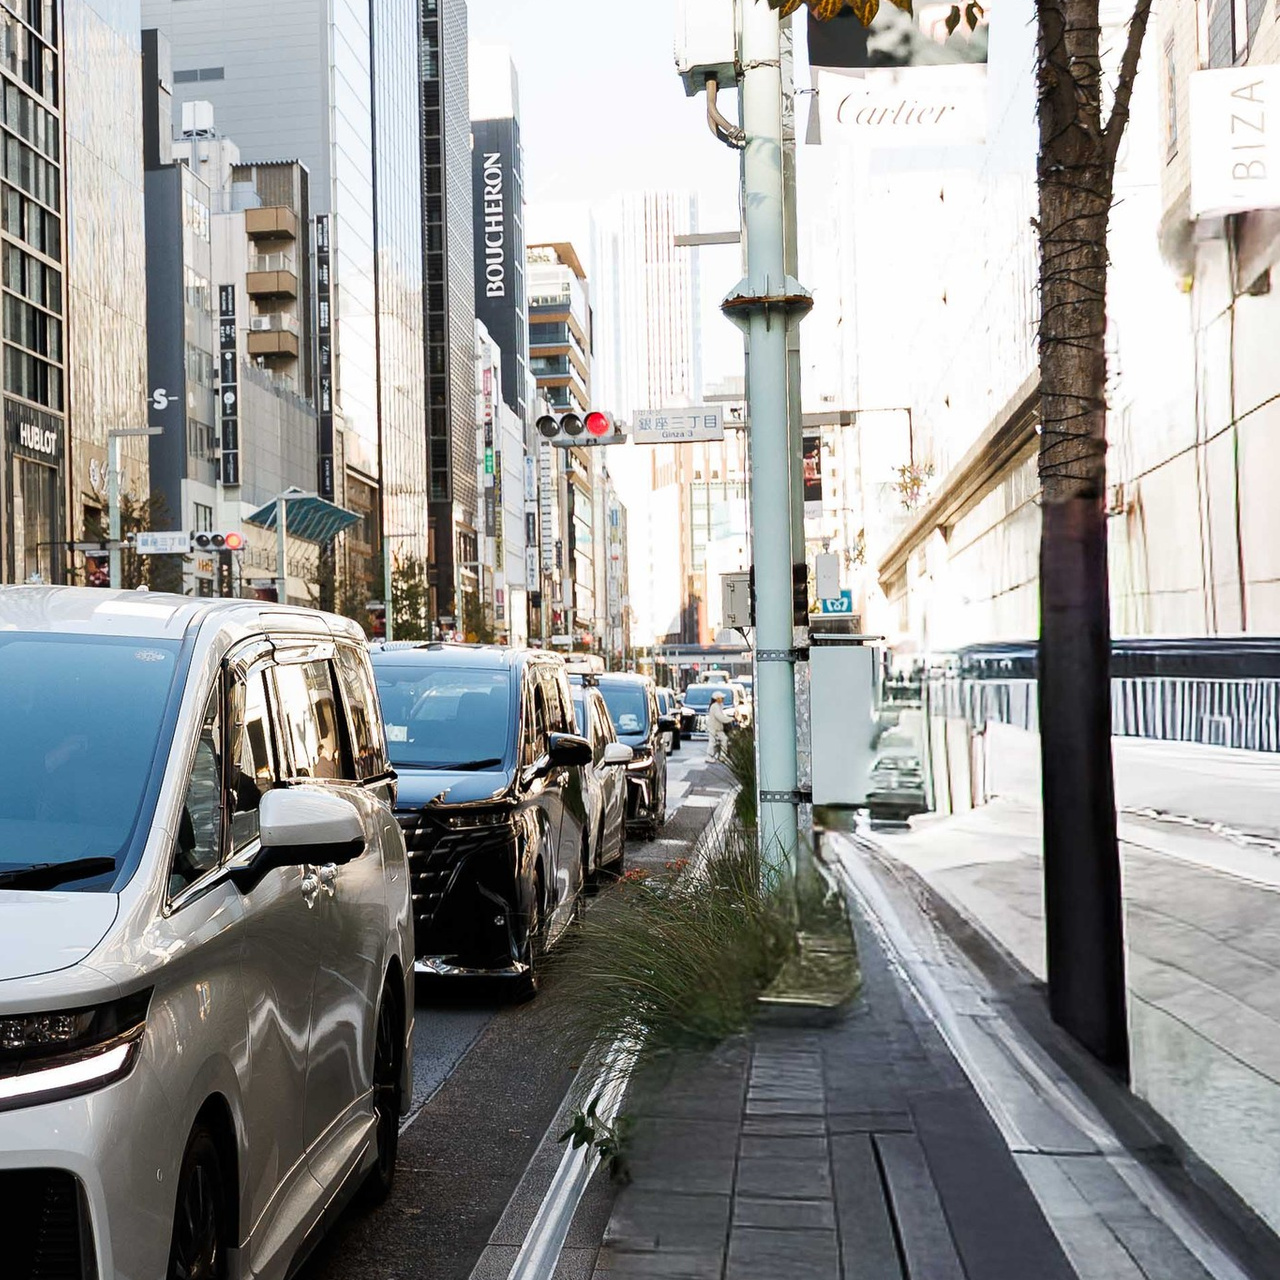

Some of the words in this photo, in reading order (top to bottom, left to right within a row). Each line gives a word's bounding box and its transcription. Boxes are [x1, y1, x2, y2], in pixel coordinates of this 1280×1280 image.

[837, 92, 955, 125] Cartier
[484, 151, 505, 298] BOUCHERON
[20, 422, 57, 455] HUBLOT
[638, 415, 717, 431] 銀座三丁目
